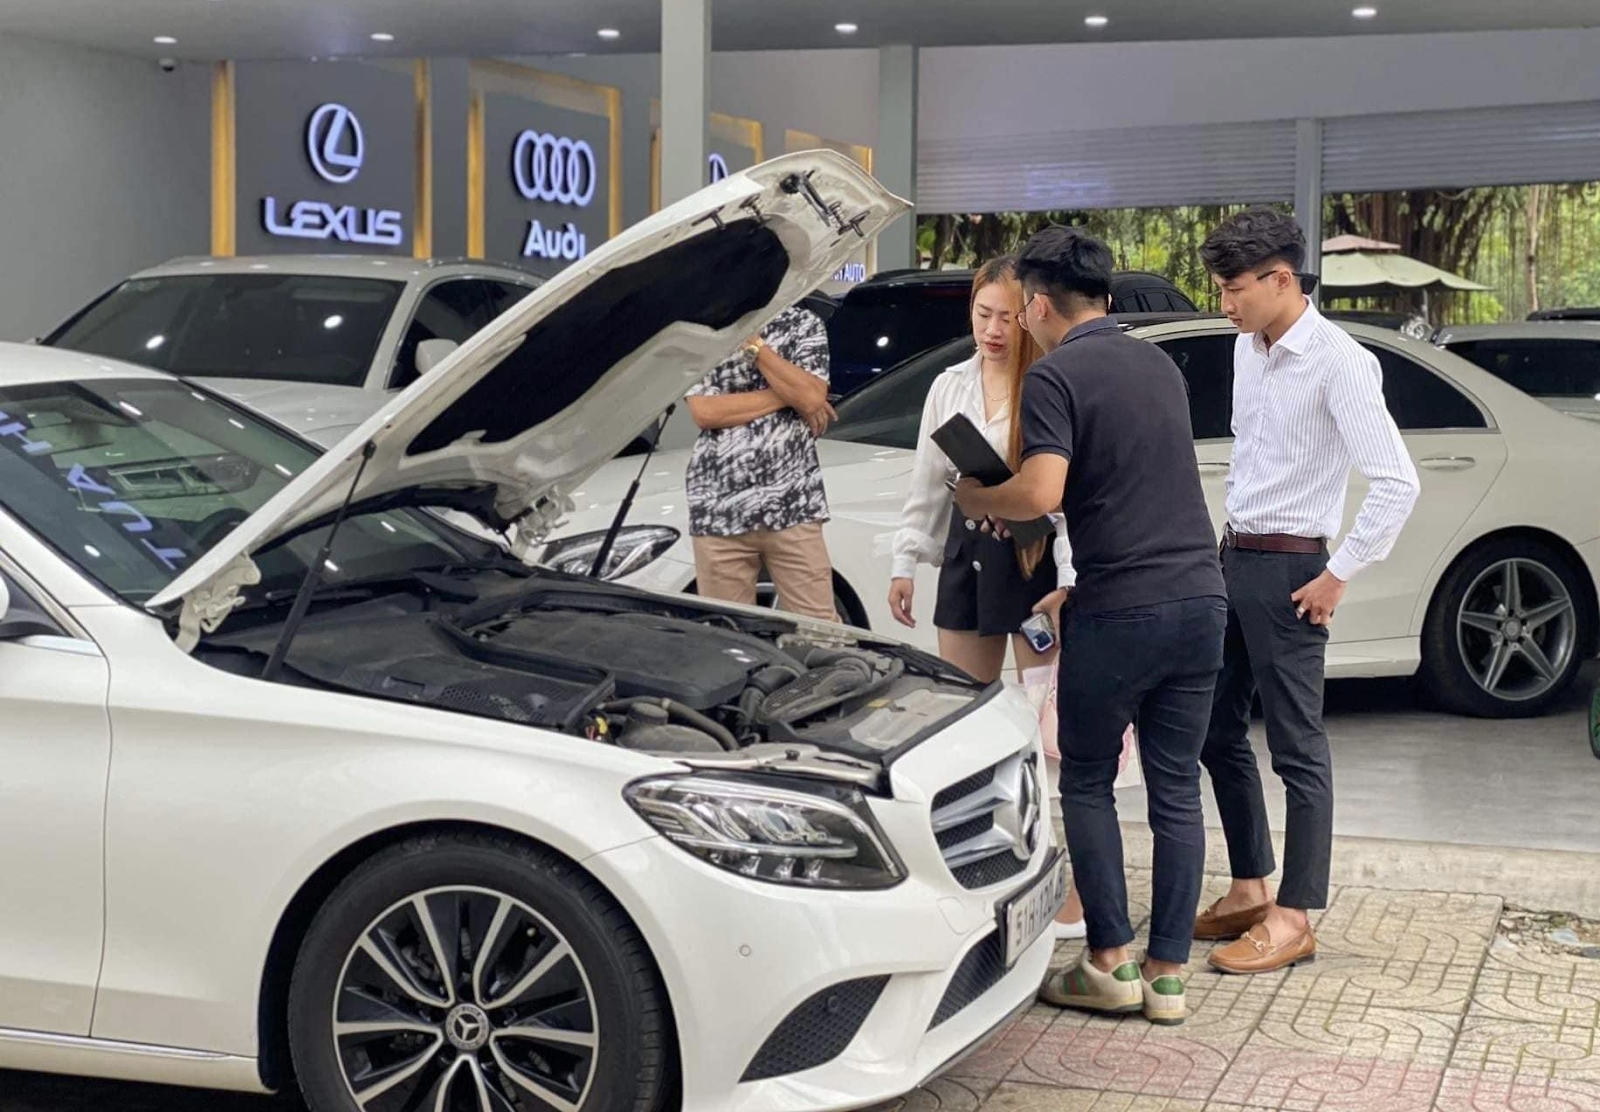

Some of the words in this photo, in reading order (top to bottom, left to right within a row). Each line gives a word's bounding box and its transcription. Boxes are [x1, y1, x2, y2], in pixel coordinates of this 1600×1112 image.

[264, 197, 403, 245] LEXUS
[523, 220, 587, 260] Audi
[843, 263, 866, 283] AUTO
